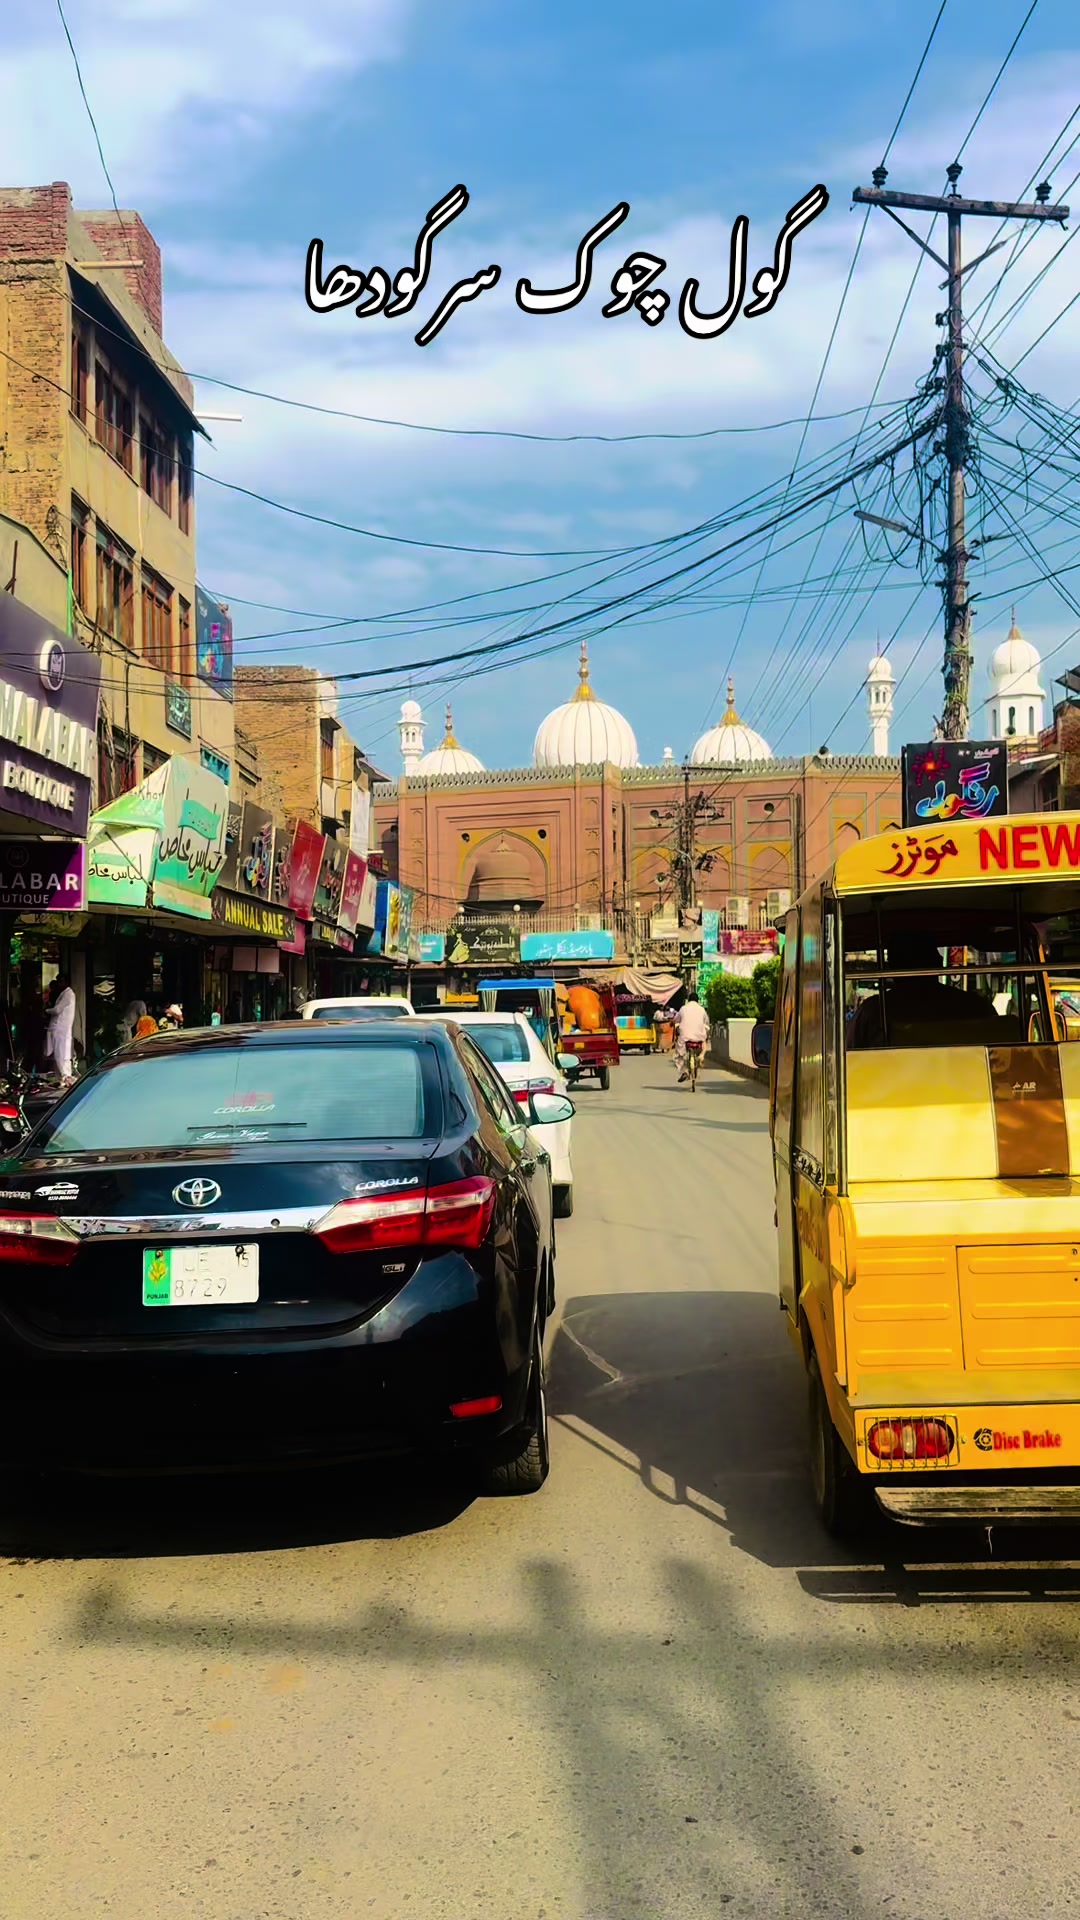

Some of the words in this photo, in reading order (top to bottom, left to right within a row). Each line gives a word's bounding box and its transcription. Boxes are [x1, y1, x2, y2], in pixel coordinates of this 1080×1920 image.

[3, 760, 76, 812] BOUTIQUE
[979, 824, 1080, 871] NEW
[225, 898, 261, 931] ANNUAL
[262, 911, 284, 936] SALE
[355, 1176, 418, 1191] COROLLA
[174, 1278, 228, 1298] 8729
[992, 1431, 1020, 1450] Disc
[1023, 1430, 1062, 1449] Brake
